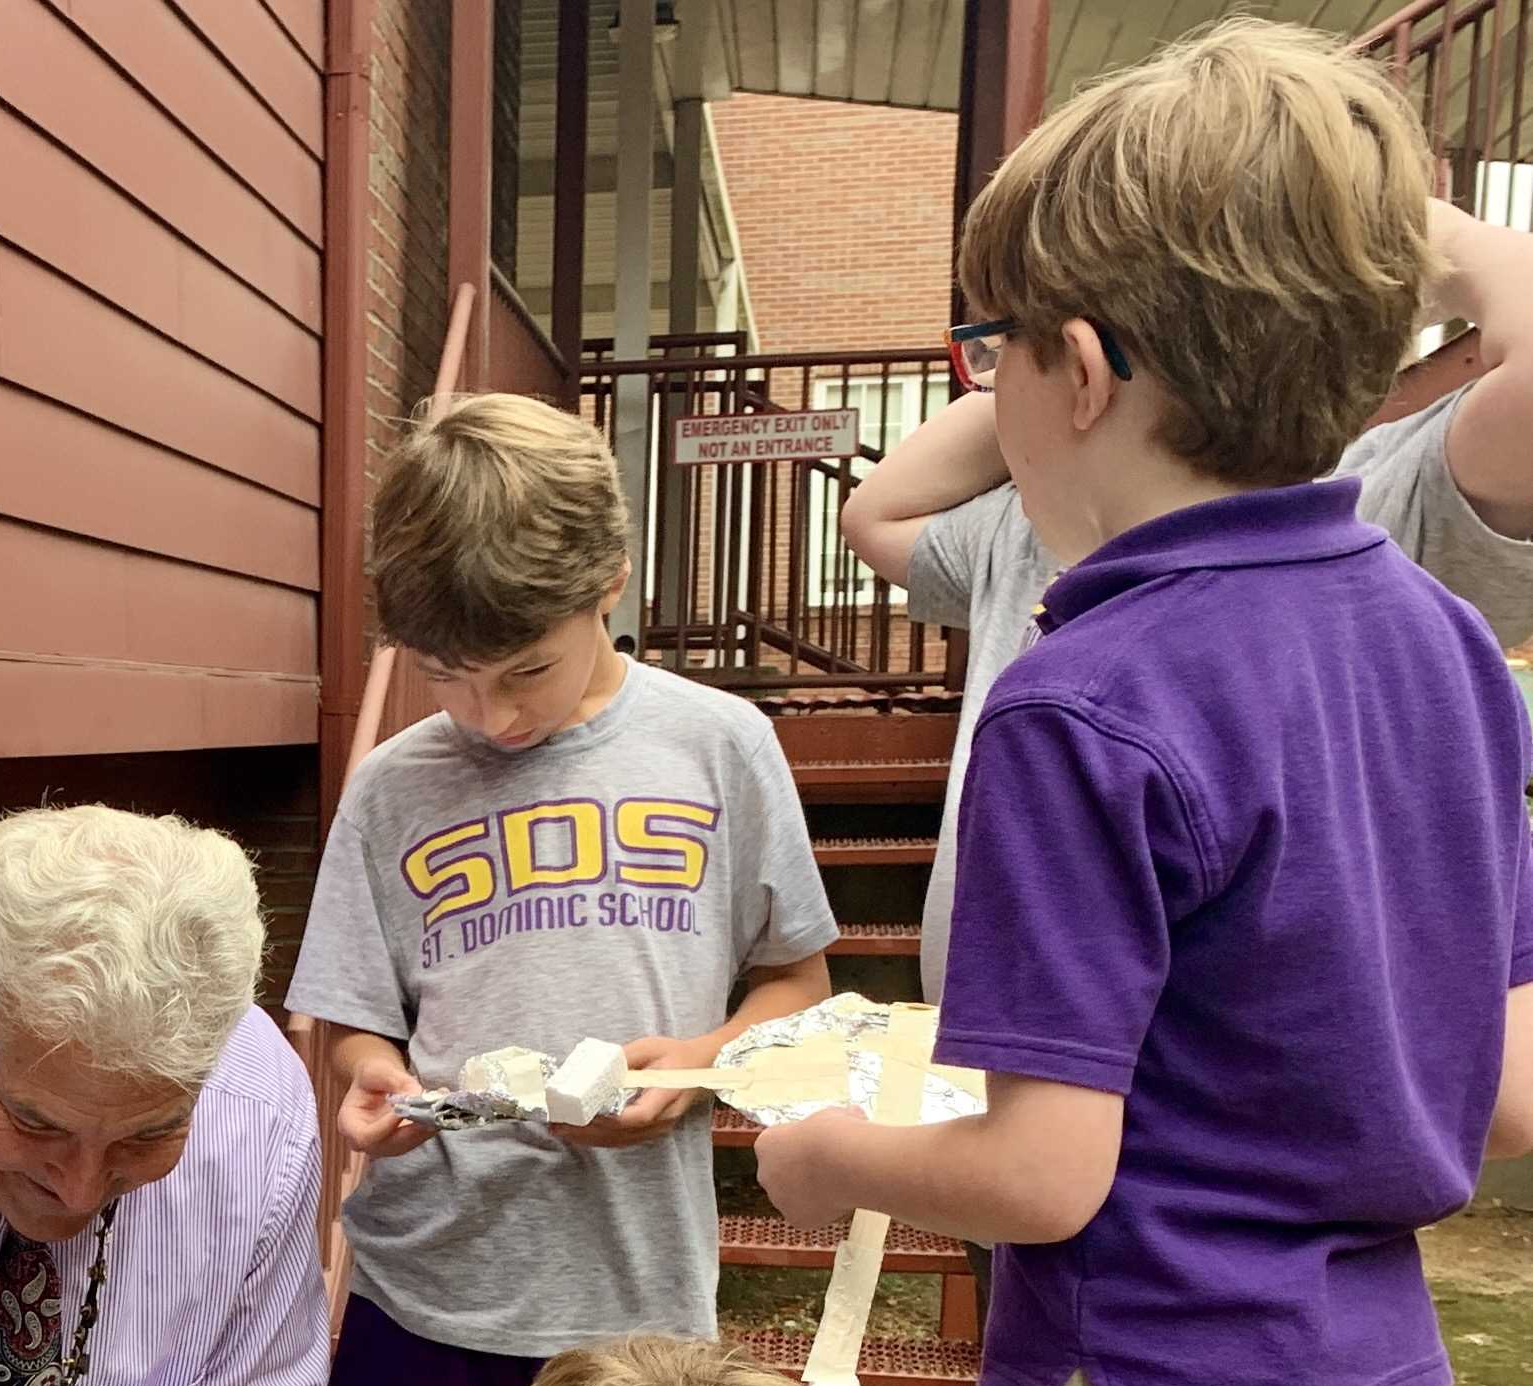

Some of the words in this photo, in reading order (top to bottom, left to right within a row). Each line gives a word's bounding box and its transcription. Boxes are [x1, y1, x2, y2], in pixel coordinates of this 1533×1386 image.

[682, 418, 770, 438] EMERGENCY
[775, 416, 807, 433] EXIT
[813, 414, 850, 432] ONLY
[698, 441, 728, 458] NOT
[731, 440, 751, 457] AN
[755, 437, 833, 455] ENTRANCE
[400, 797, 722, 933] SDS
[421, 929, 455, 969] ST.
[461, 893, 588, 954] DOMINIC
[598, 893, 701, 936] SCHOOL
